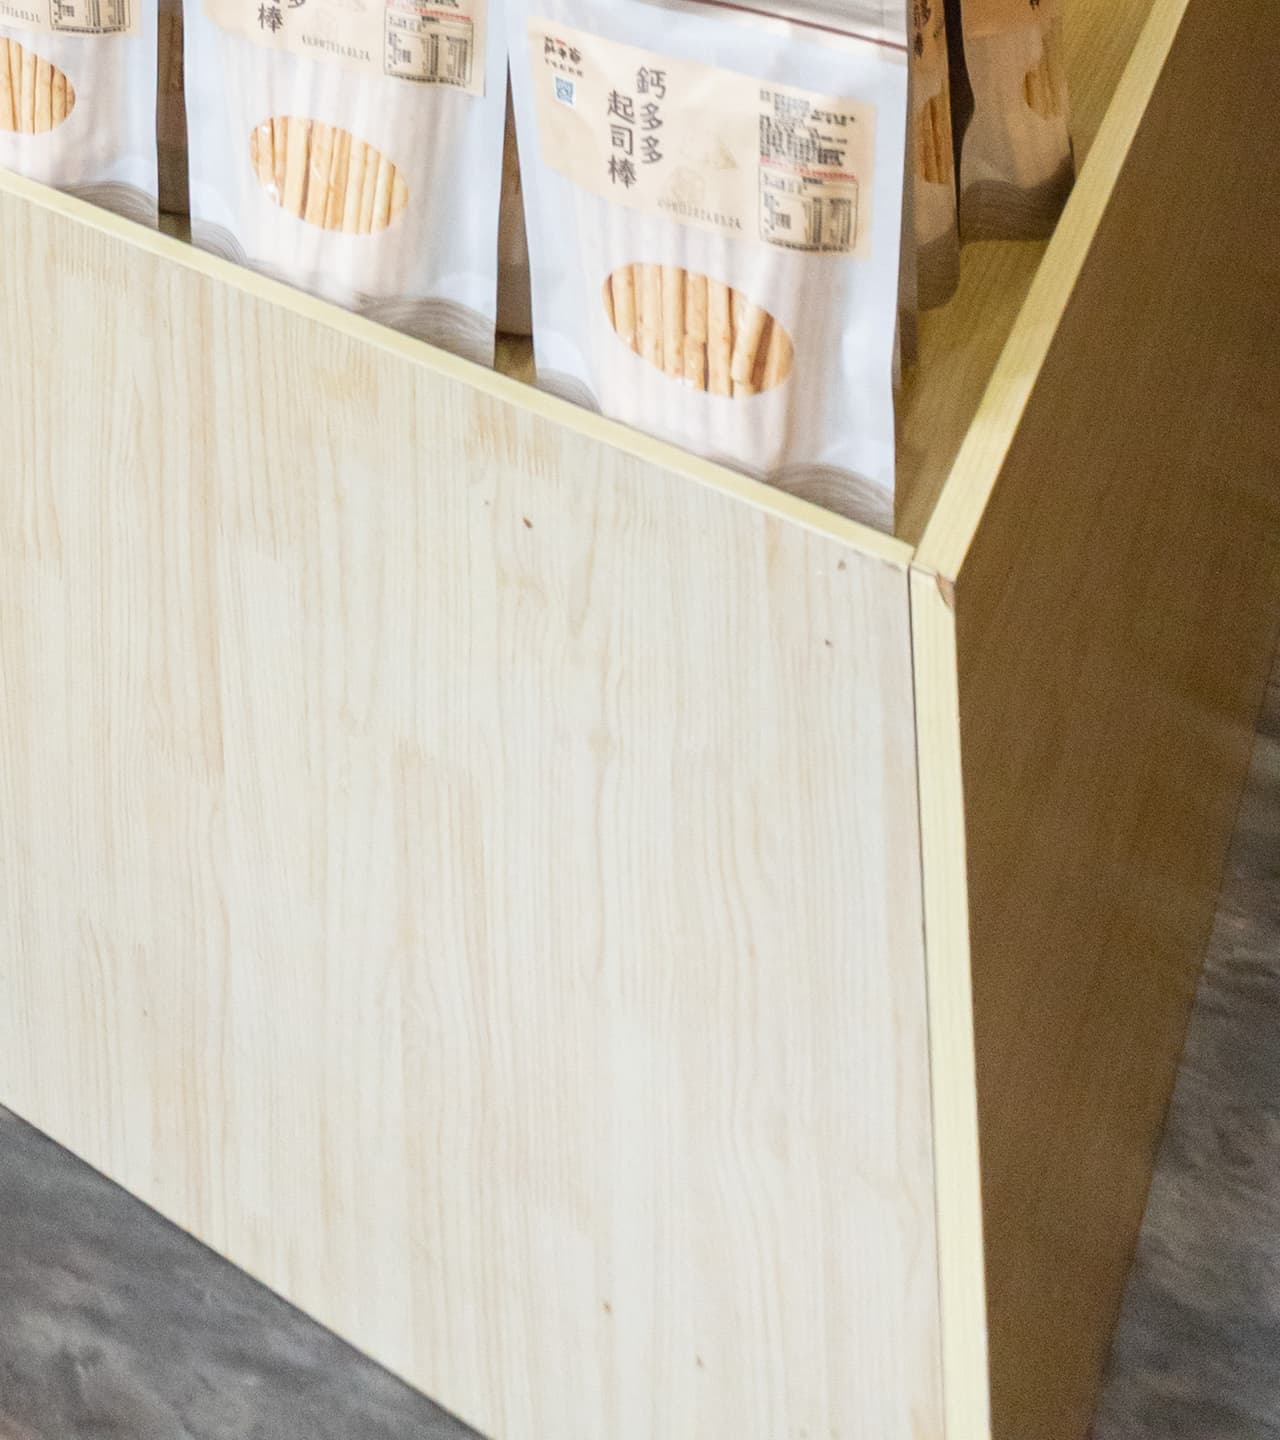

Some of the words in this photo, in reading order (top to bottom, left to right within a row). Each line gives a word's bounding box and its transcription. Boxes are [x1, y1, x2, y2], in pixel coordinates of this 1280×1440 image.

[605, 88, 639, 192] 起司棒
[634, 63, 667, 167] 鈣多多
